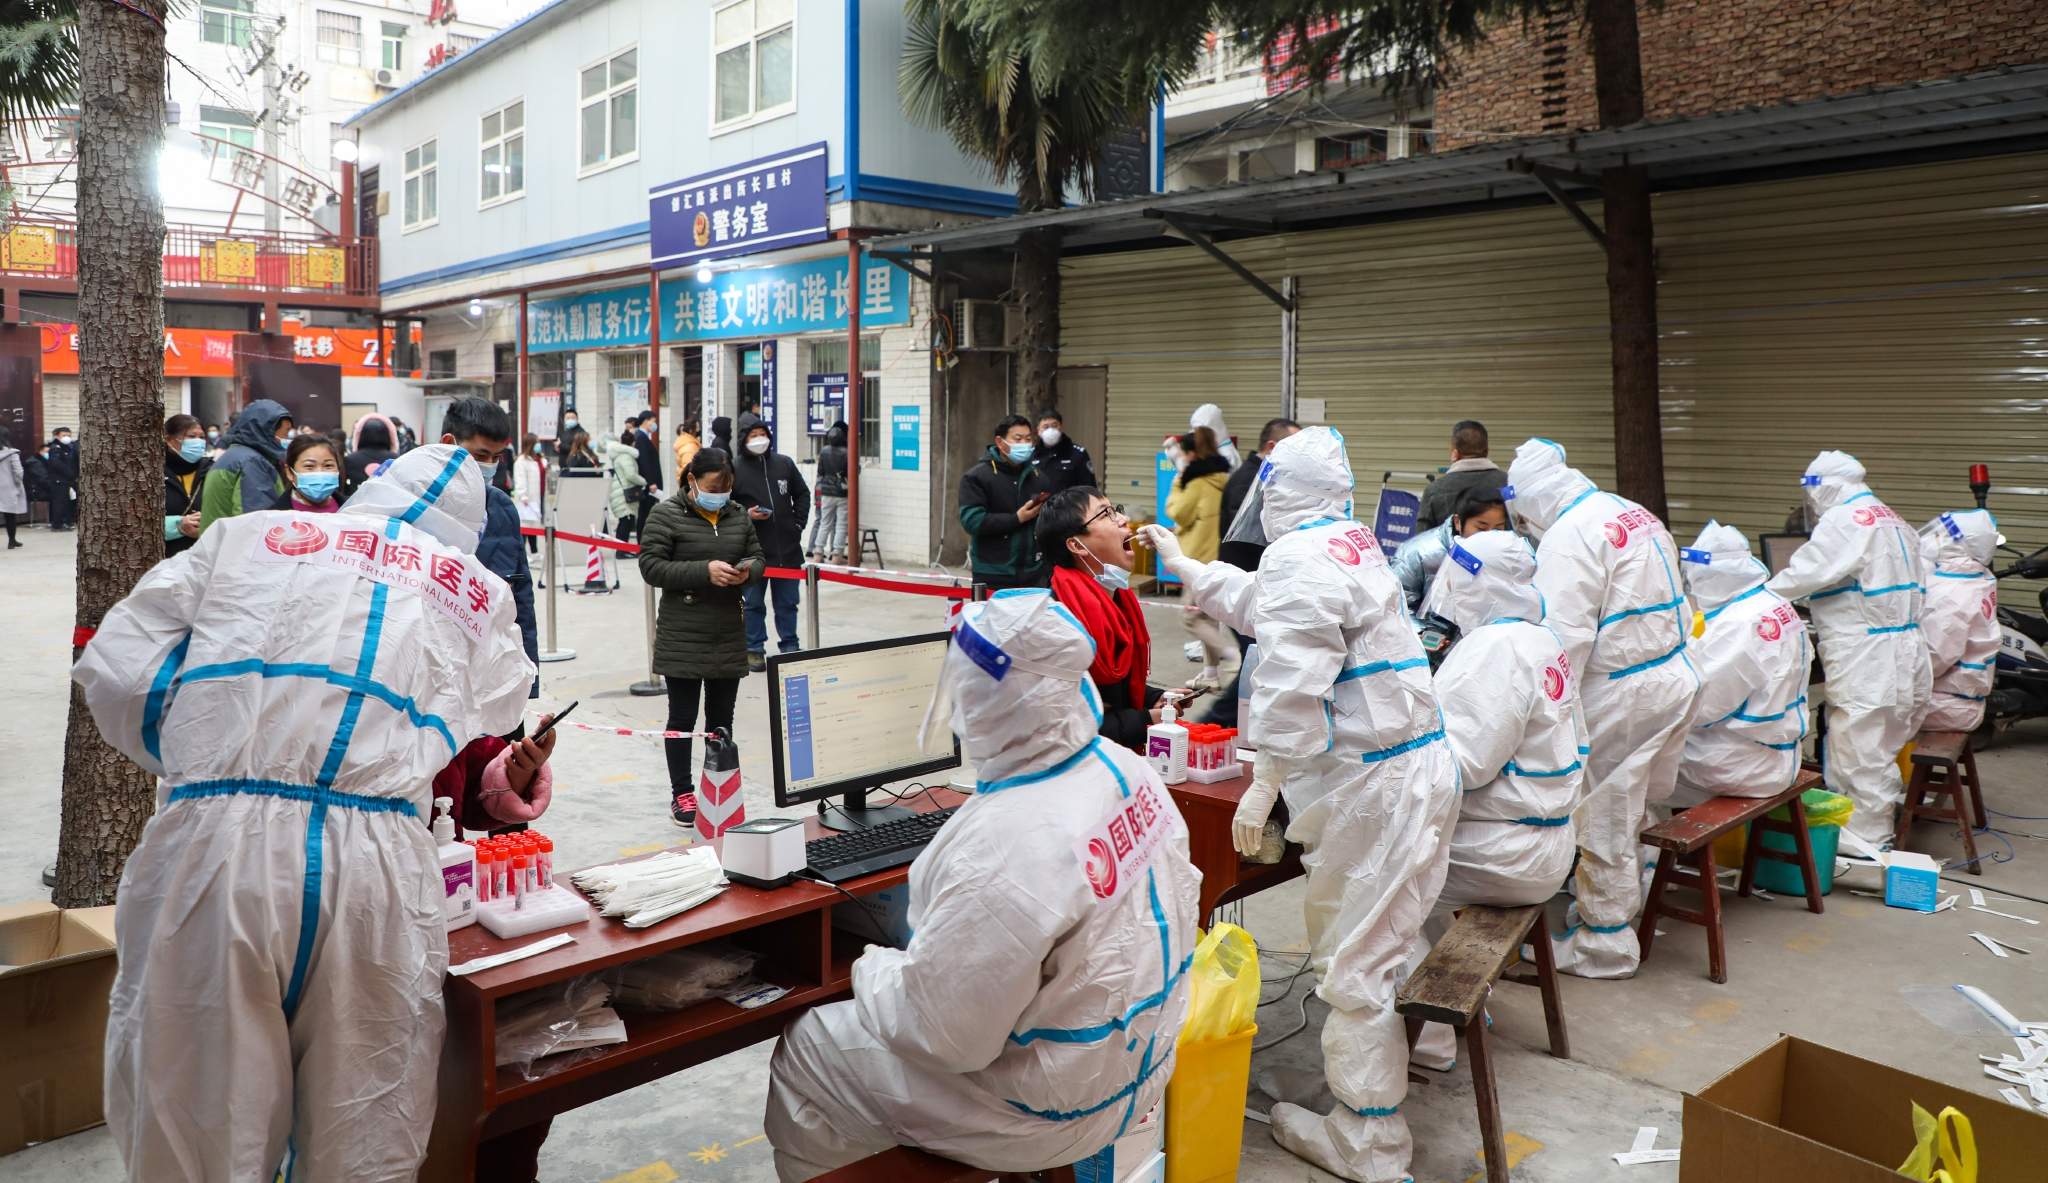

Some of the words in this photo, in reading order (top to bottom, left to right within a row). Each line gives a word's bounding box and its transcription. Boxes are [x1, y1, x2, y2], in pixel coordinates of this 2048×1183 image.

[671, 168, 792, 213] 创汇路派出所长里村
[712, 200, 769, 242] 警务室
[674, 265, 894, 333] 共建文明和谐长里
[332, 554, 442, 604] INTERNATIONAL
[443, 596, 483, 638] MEDICAL
[335, 530, 490, 615] 国际医学
[2002, 634, 2024, 652] 巡逻
